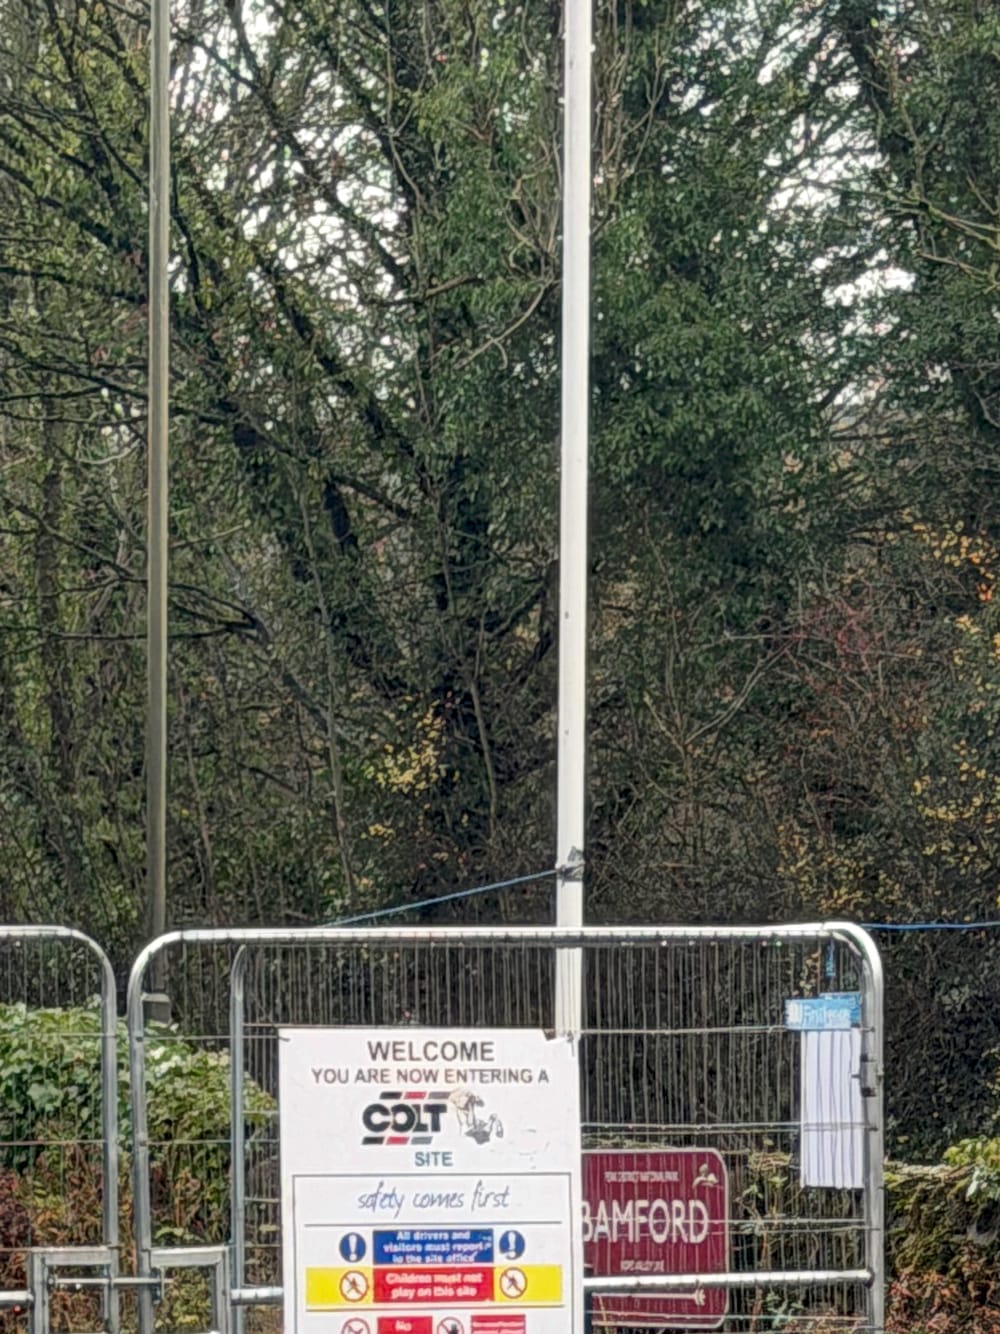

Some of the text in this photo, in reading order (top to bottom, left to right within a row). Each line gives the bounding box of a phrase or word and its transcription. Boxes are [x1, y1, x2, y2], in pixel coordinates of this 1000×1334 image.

[367, 1041, 494, 1061] WELCOME
[311, 1068, 549, 1084] YOU ARE NOW ENTERING A
[362, 1103, 448, 1132] COLT
[414, 1151, 453, 1167] SITE
[357, 1180, 510, 1218] safety comes first
[581, 1198, 709, 1244] BAMFORD
[397, 1231, 470, 1240] All drivers and
[383, 1242, 422, 1252] visitors
[425, 1242, 450, 1251] must
[406, 1254, 422, 1263] the
[385, 1273, 432, 1284] Children
[433, 1273, 461, 1283] must
[391, 1286, 478, 1300] play on this site
[395, 1320, 412, 1331] No
